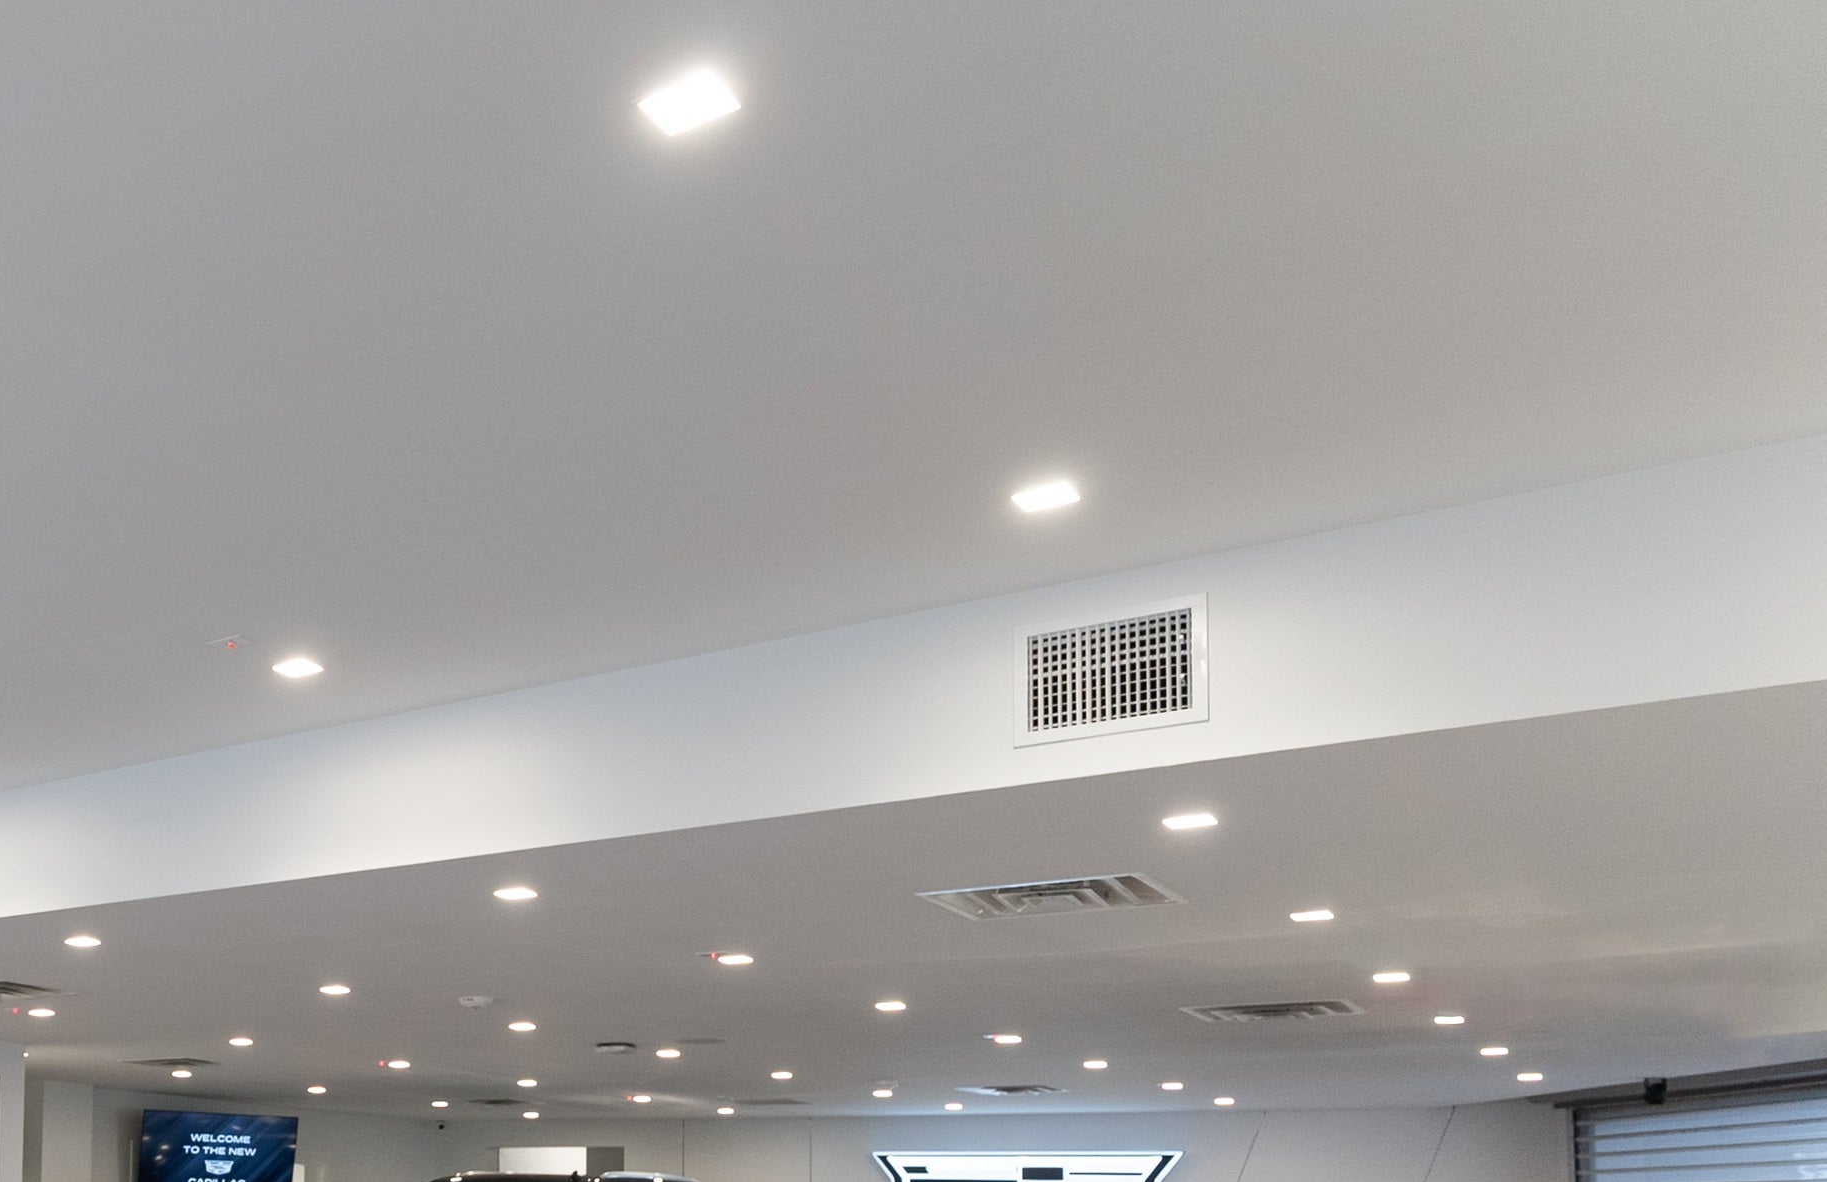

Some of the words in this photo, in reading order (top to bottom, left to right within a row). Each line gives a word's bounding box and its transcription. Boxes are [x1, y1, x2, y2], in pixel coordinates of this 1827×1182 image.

[190, 1133, 251, 1144] WELCOME
[183, 1145, 200, 1154] TO
[202, 1146, 226, 1155] THE
[228, 1147, 257, 1156] NEW
